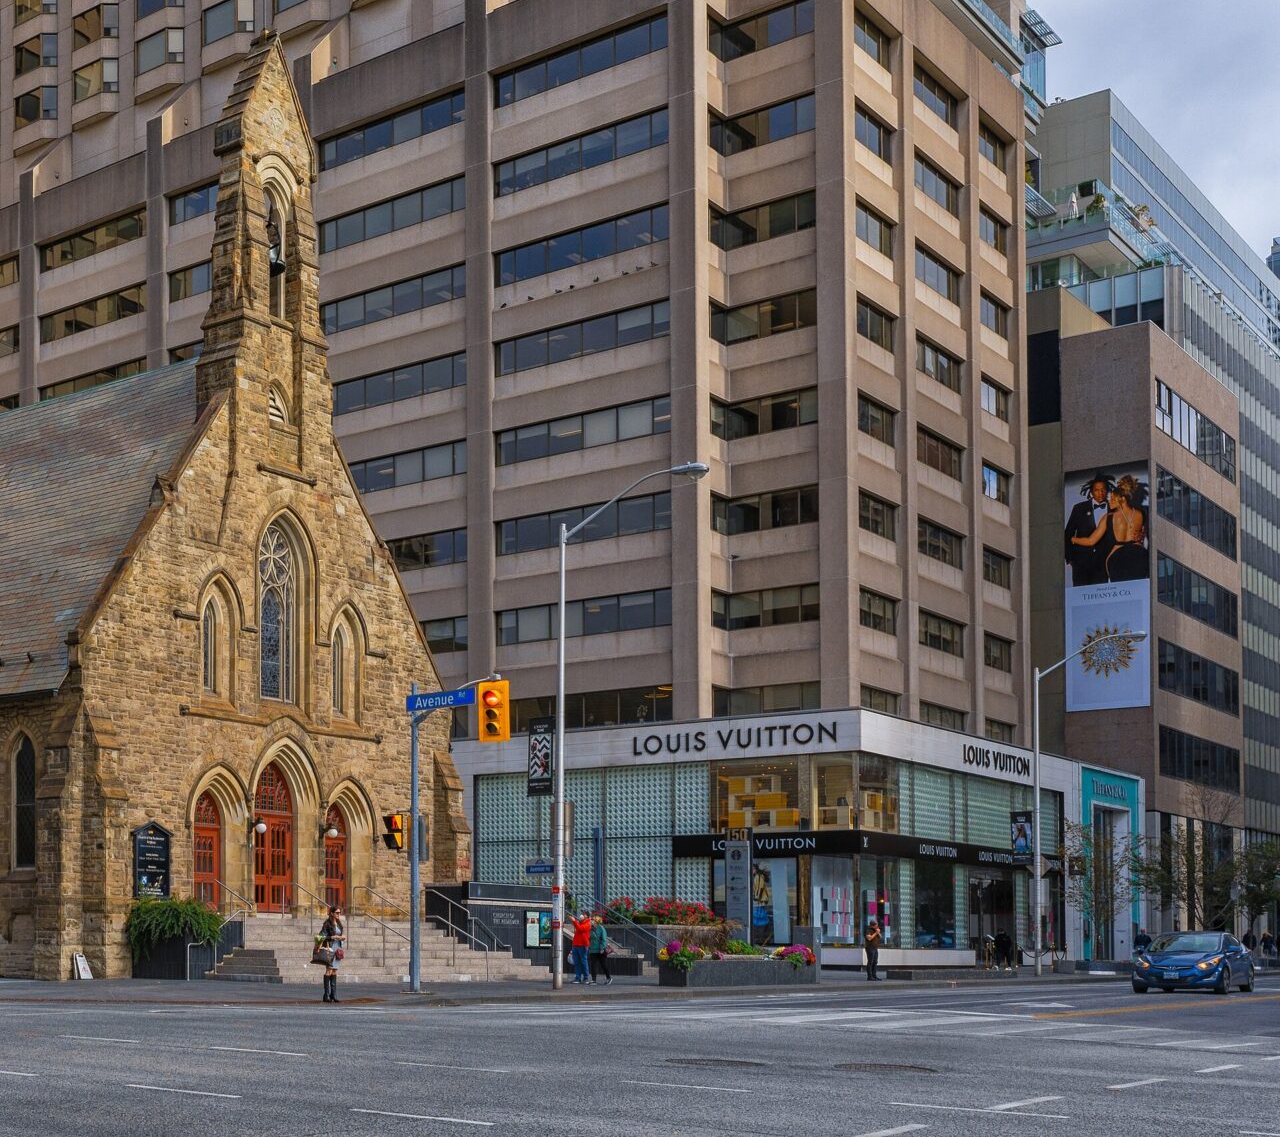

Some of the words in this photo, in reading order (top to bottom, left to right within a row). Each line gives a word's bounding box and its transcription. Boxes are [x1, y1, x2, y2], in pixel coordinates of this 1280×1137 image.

[415, 695, 454, 708] Avenue
[633, 731, 706, 756] LOUIS
[717, 721, 837, 750] VUITTON
[963, 743, 990, 768] LOUIS
[992, 750, 1030, 777] VUITTON
[727, 828, 748, 841] 150
[756, 837, 816, 850] VUITTON
[919, 844, 935, 855] LOUIS
[935, 846, 958, 858] VUITTON
[978, 851, 993, 862] LOUIS
[994, 853, 1013, 864] VUITTON
